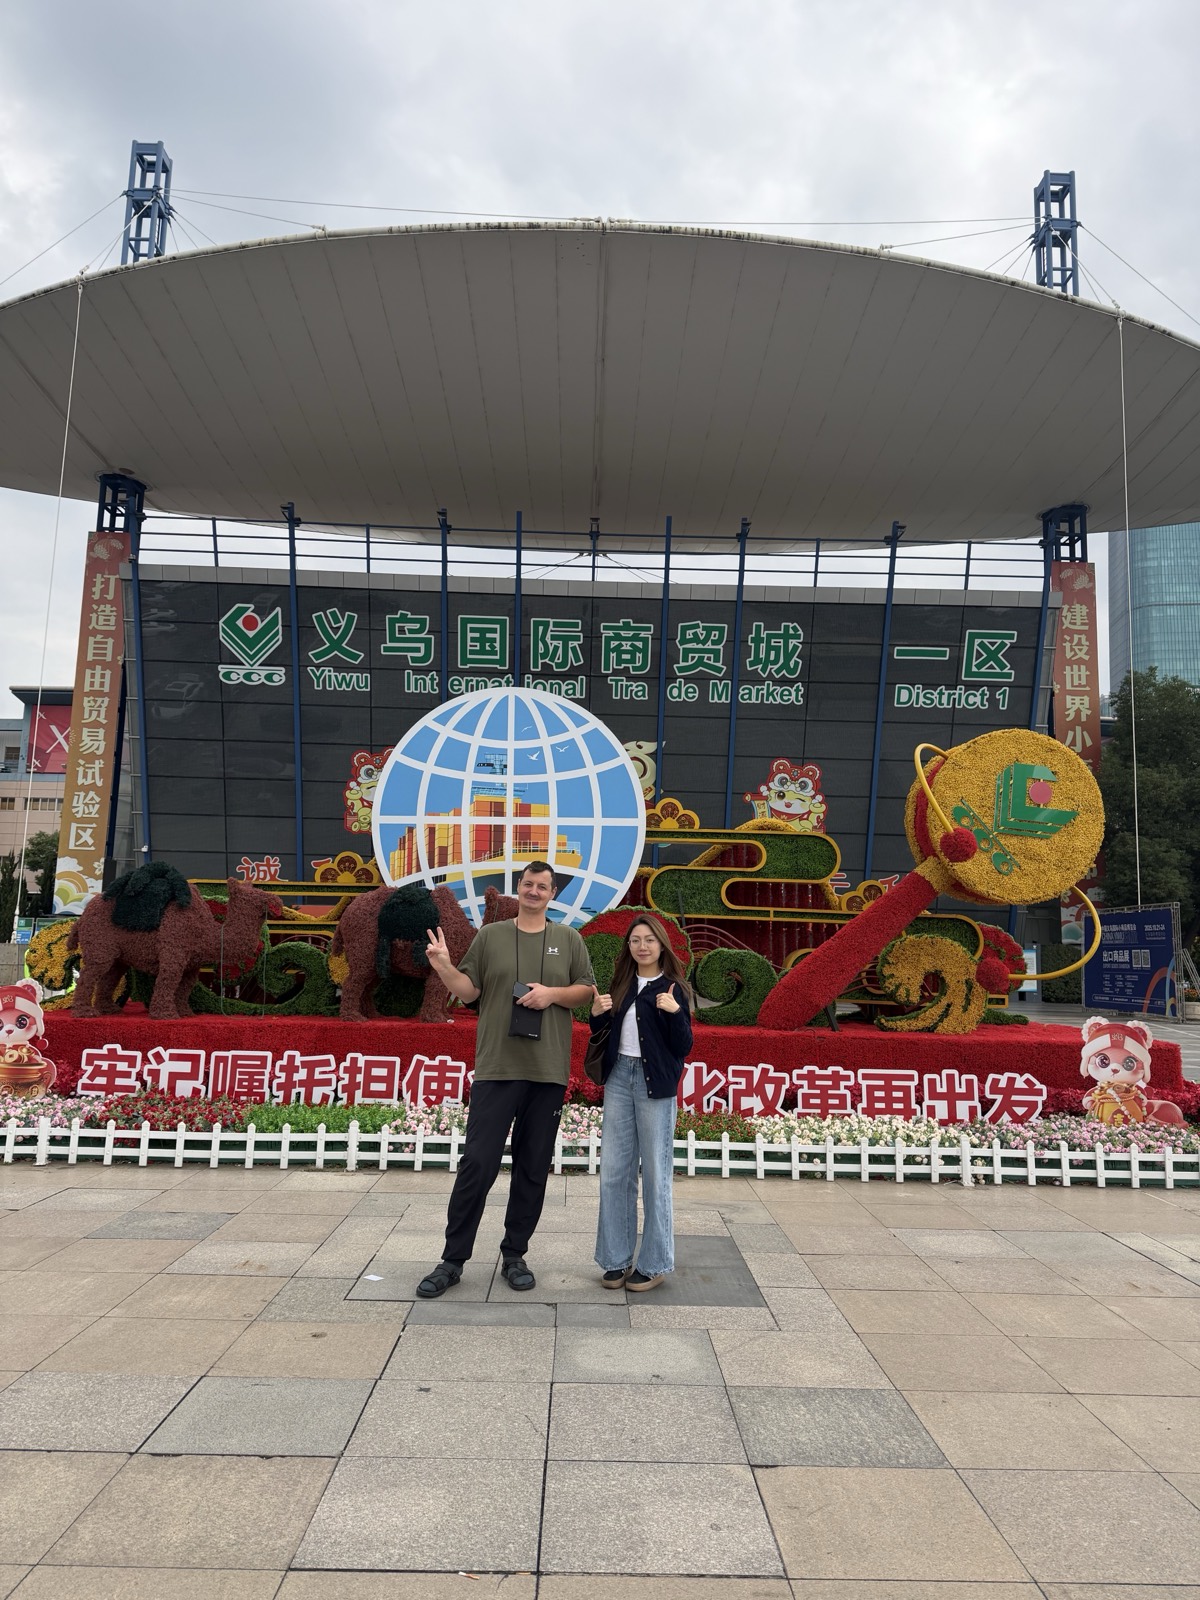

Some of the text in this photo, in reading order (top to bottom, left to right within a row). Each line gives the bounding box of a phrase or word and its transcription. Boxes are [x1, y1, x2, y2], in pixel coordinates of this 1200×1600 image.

[308, 608, 1017, 681] 义乌国际商贸城 一区
[68, 574, 119, 850] 打造自由贸易试验区
[307, 667, 370, 691] Yiwu
[894, 684, 989, 709] District
[996, 687, 1009, 710] 1
[1061, 603, 1093, 772] 建设世界小
[1102, 949, 1130, 963] 出口商品展
[77, 1043, 475, 1108] 牢记嘱托担使
